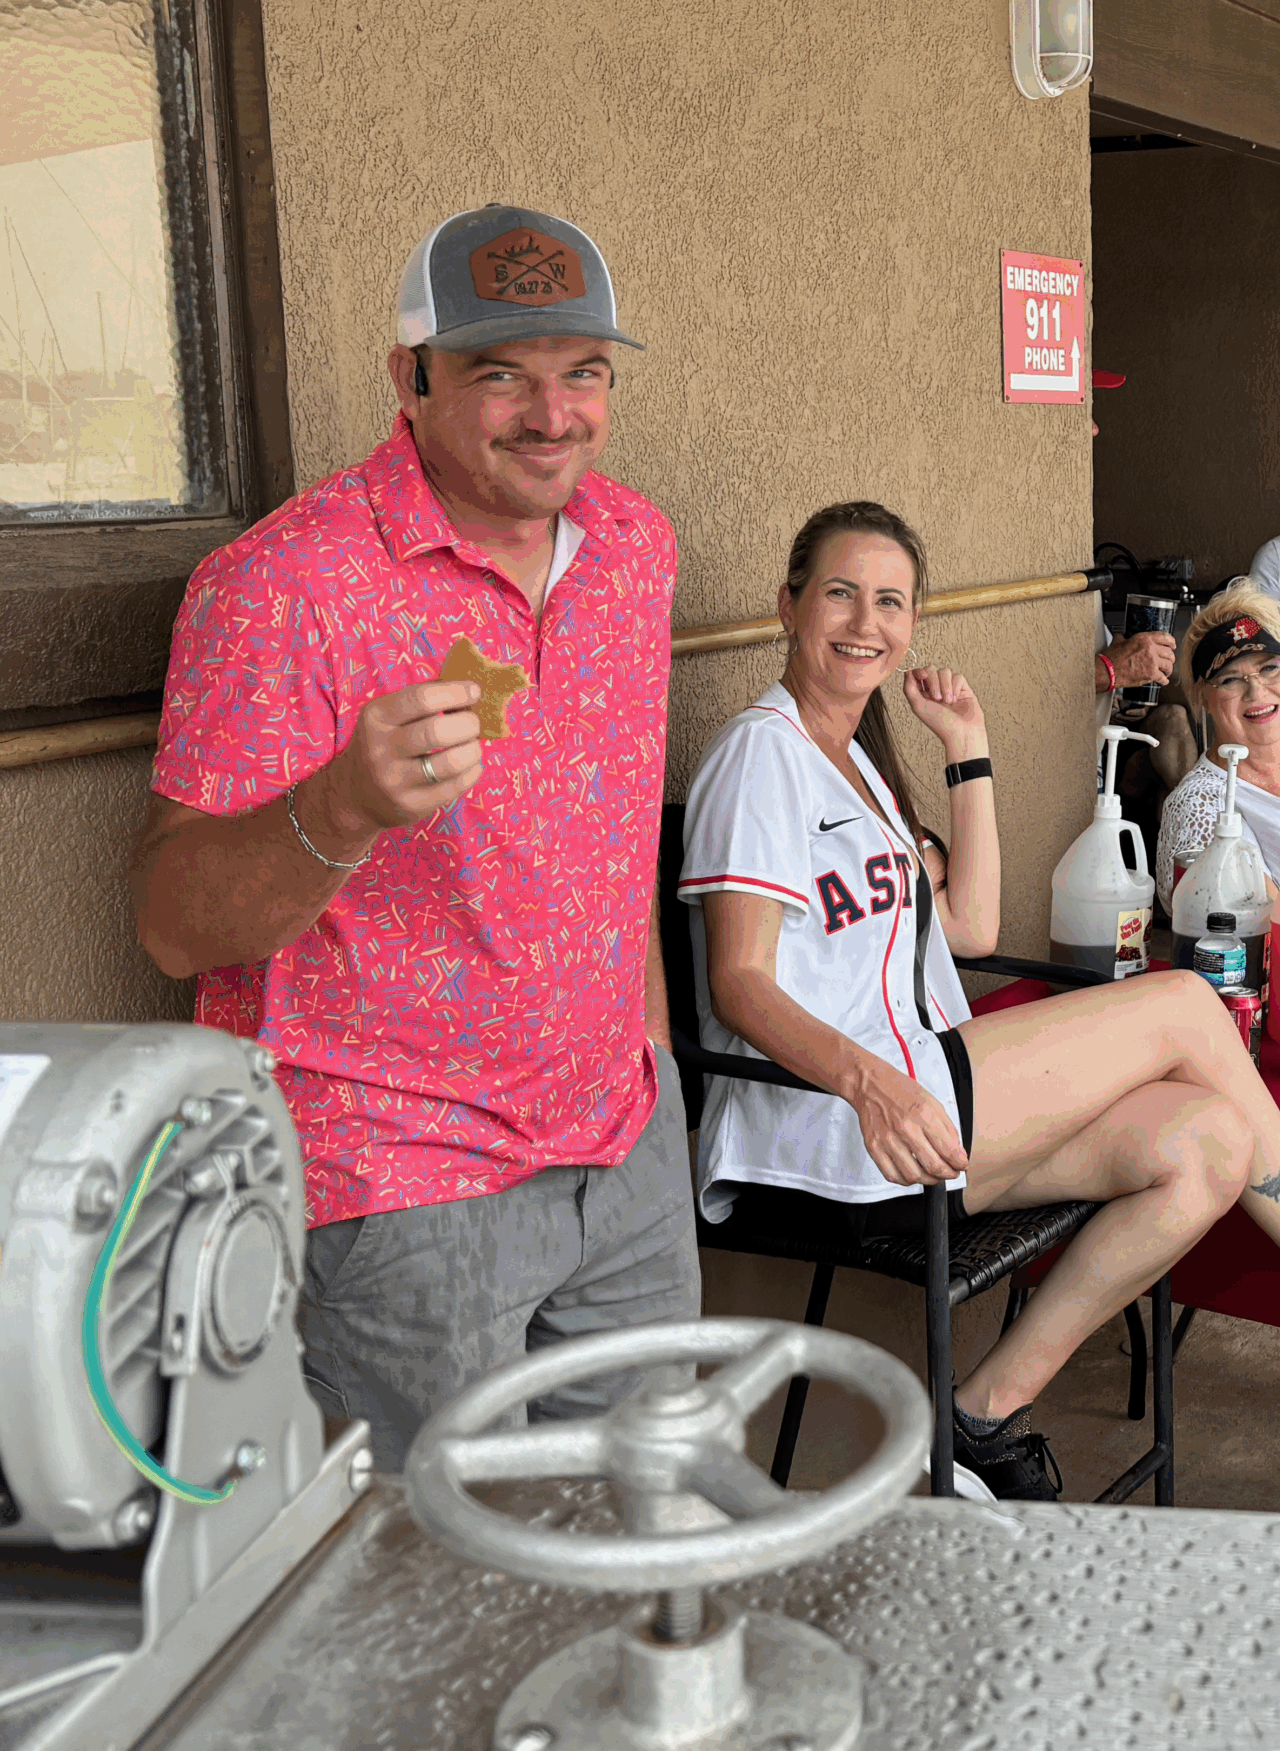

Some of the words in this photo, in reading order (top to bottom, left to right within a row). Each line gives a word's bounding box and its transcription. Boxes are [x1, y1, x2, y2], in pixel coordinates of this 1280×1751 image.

[1006, 266, 1079, 297] EMERGENCY
[1025, 298, 1061, 342] 911
[1024, 346, 1066, 371] PHONE
